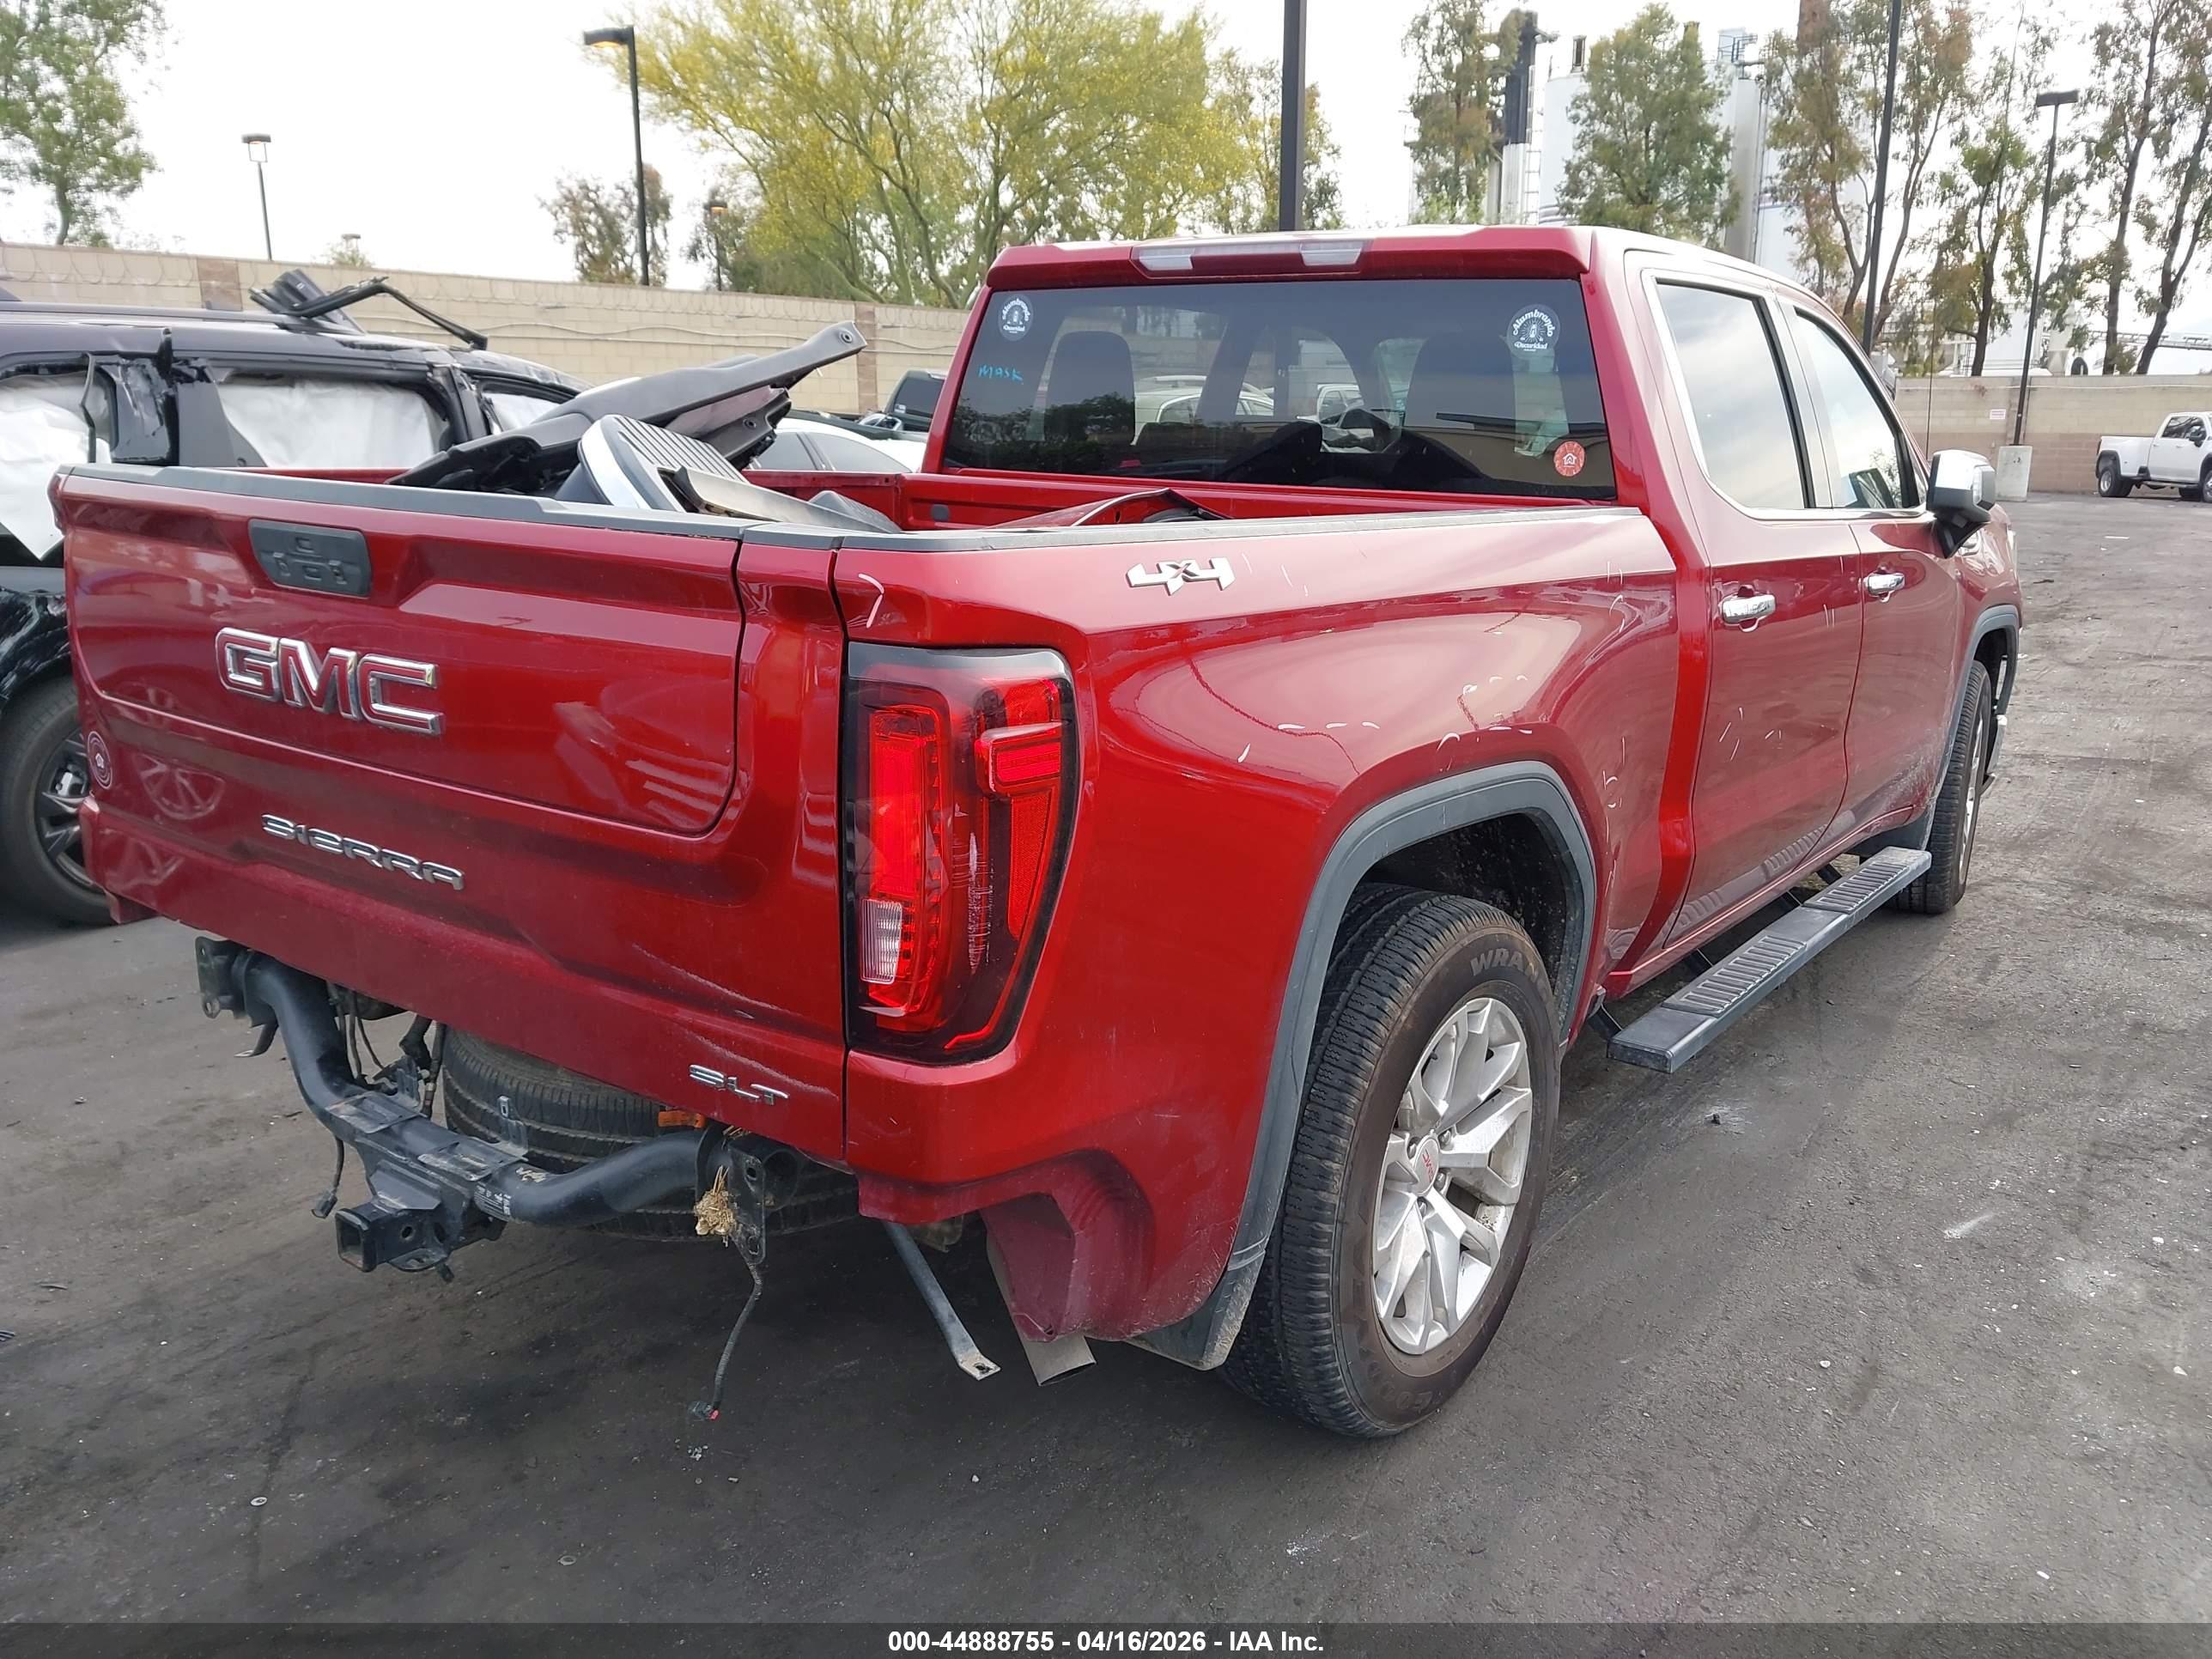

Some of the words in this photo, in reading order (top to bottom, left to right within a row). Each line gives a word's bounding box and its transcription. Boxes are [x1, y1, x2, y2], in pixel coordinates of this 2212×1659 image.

[1513, 309, 1555, 337] Alumbrando
[215, 627, 446, 736] GMC
[261, 813, 465, 890] SIERRA
[688, 1064, 789, 1106] SLT
